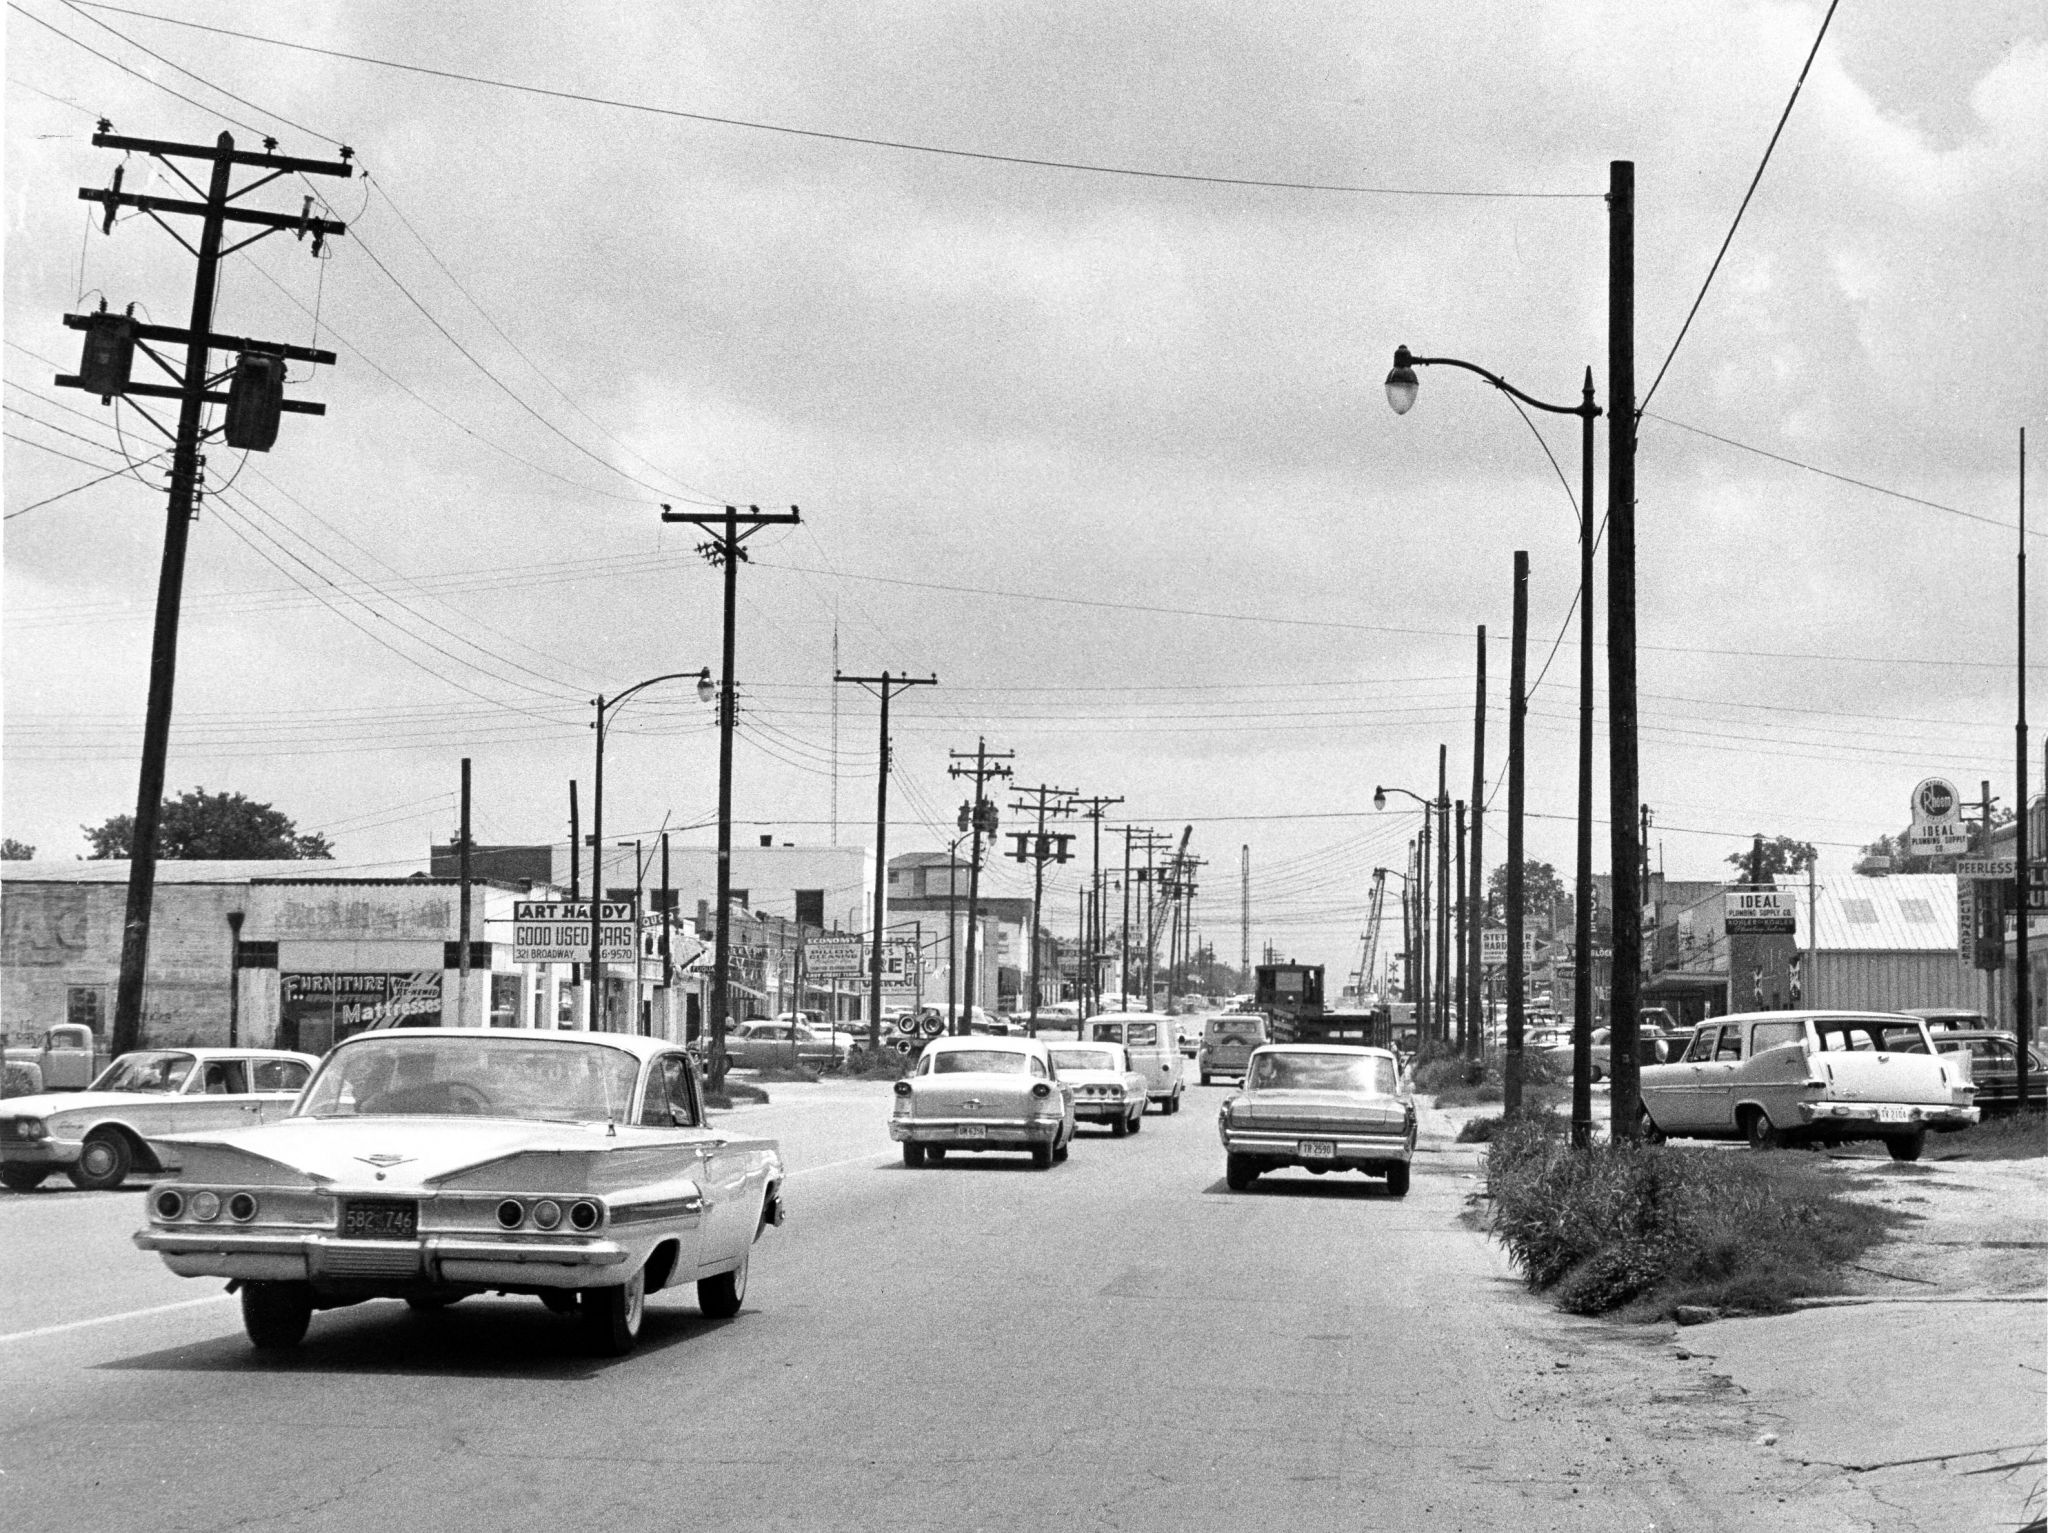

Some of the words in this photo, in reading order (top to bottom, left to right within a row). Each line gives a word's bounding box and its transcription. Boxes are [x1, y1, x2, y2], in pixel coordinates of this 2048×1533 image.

[1923, 825, 1954, 837] IDEAL
[1958, 862, 2013, 874] PEERLESS
[1740, 895, 1780, 908] IDEAL
[520, 904, 557, 919] ART
[562, 904, 627, 919] HADY
[1728, 909, 1757, 917] PLUMBING
[1759, 909, 1780, 917] SUPPLY
[516, 926, 552, 946] GOOD
[556, 926, 589, 946] USED
[1484, 942, 1532, 950] HARDE
[515, 949, 530, 959] 321
[281, 975, 385, 1002] FURNITURE
[342, 998, 441, 1025] Mattresses
[346, 1210, 375, 1227] 582
[386, 1211, 413, 1228] 746
